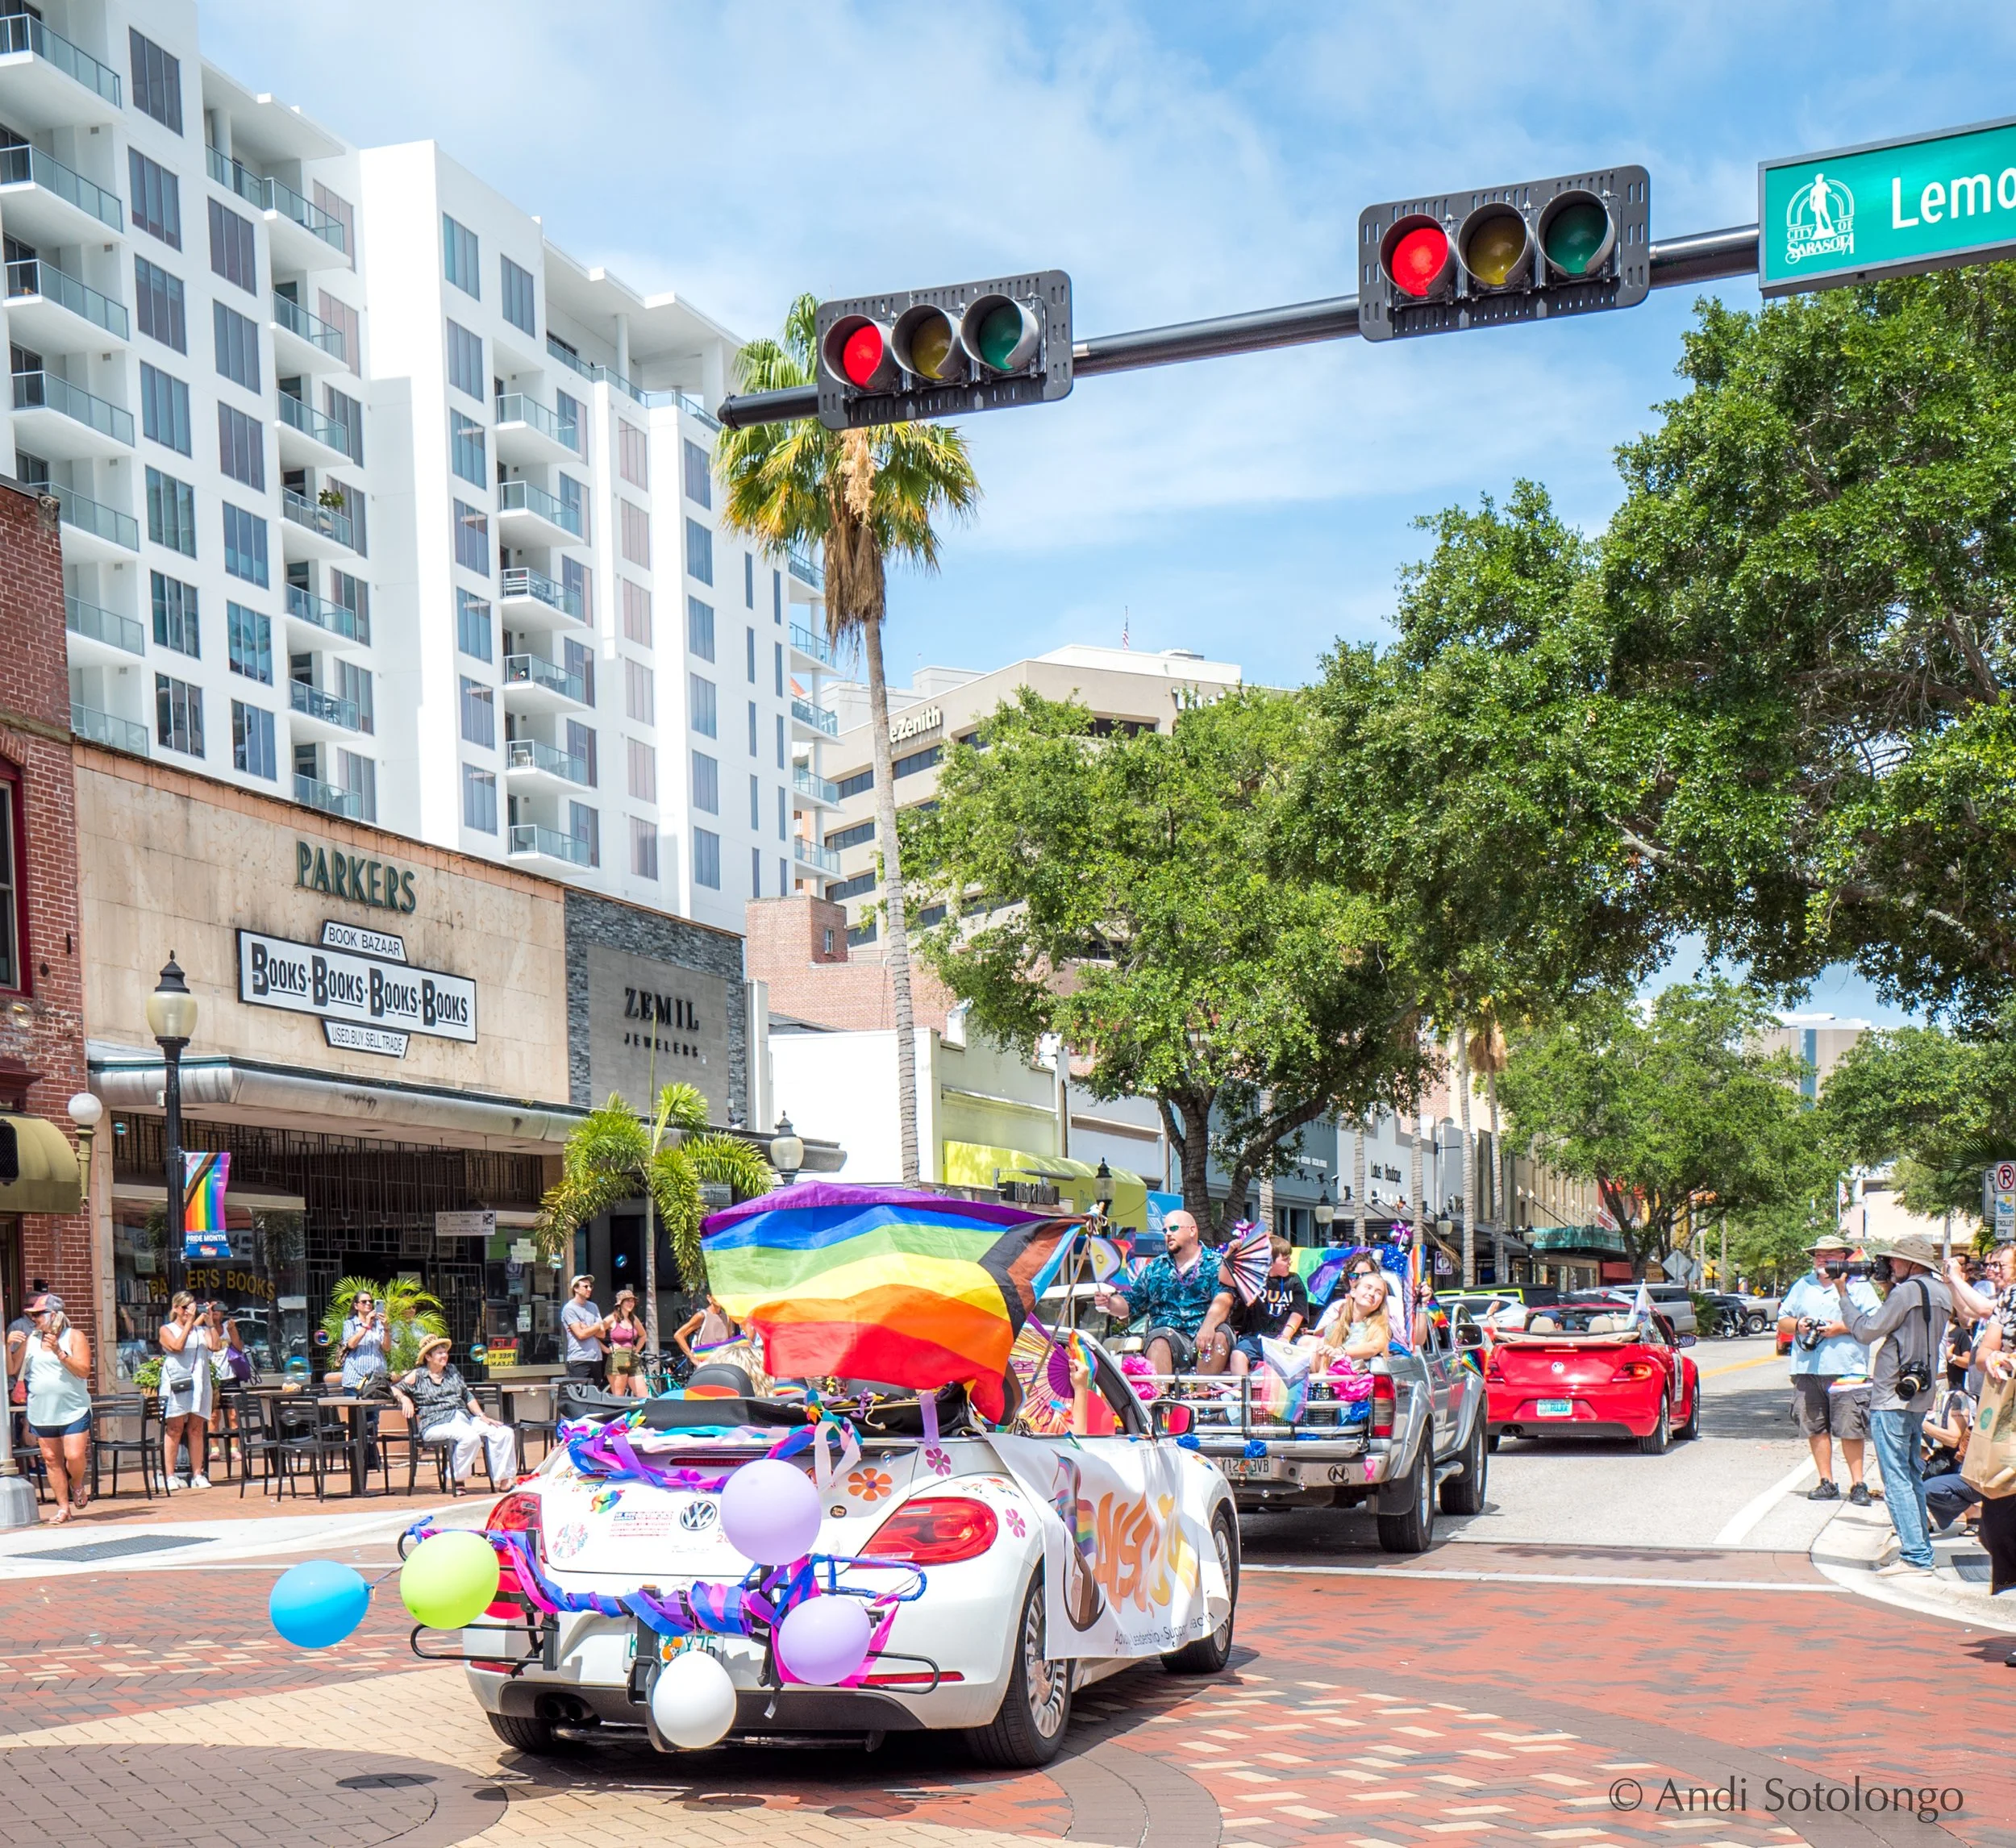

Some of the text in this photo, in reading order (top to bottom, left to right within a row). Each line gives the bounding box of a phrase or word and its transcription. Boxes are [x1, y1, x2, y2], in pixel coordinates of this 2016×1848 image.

[1892, 167, 2016, 230] Lemo
[1787, 219, 1854, 240] CITY OF
[1785, 232, 1854, 264] SARASOTA
[889, 706, 941, 743] eZenith
[296, 841, 416, 914] PARKERS
[329, 926, 401, 957] BOOK BAZAAR
[252, 943, 468, 1026] BOOKS BOOKS BOOKS BOOKS
[624, 987, 699, 1030] ZEMIL
[624, 1032, 698, 1058] JEWELERS
[185, 1234, 227, 1243] PRIDE MONTH
[148, 1268, 276, 1301] PAER'S BOOKS
